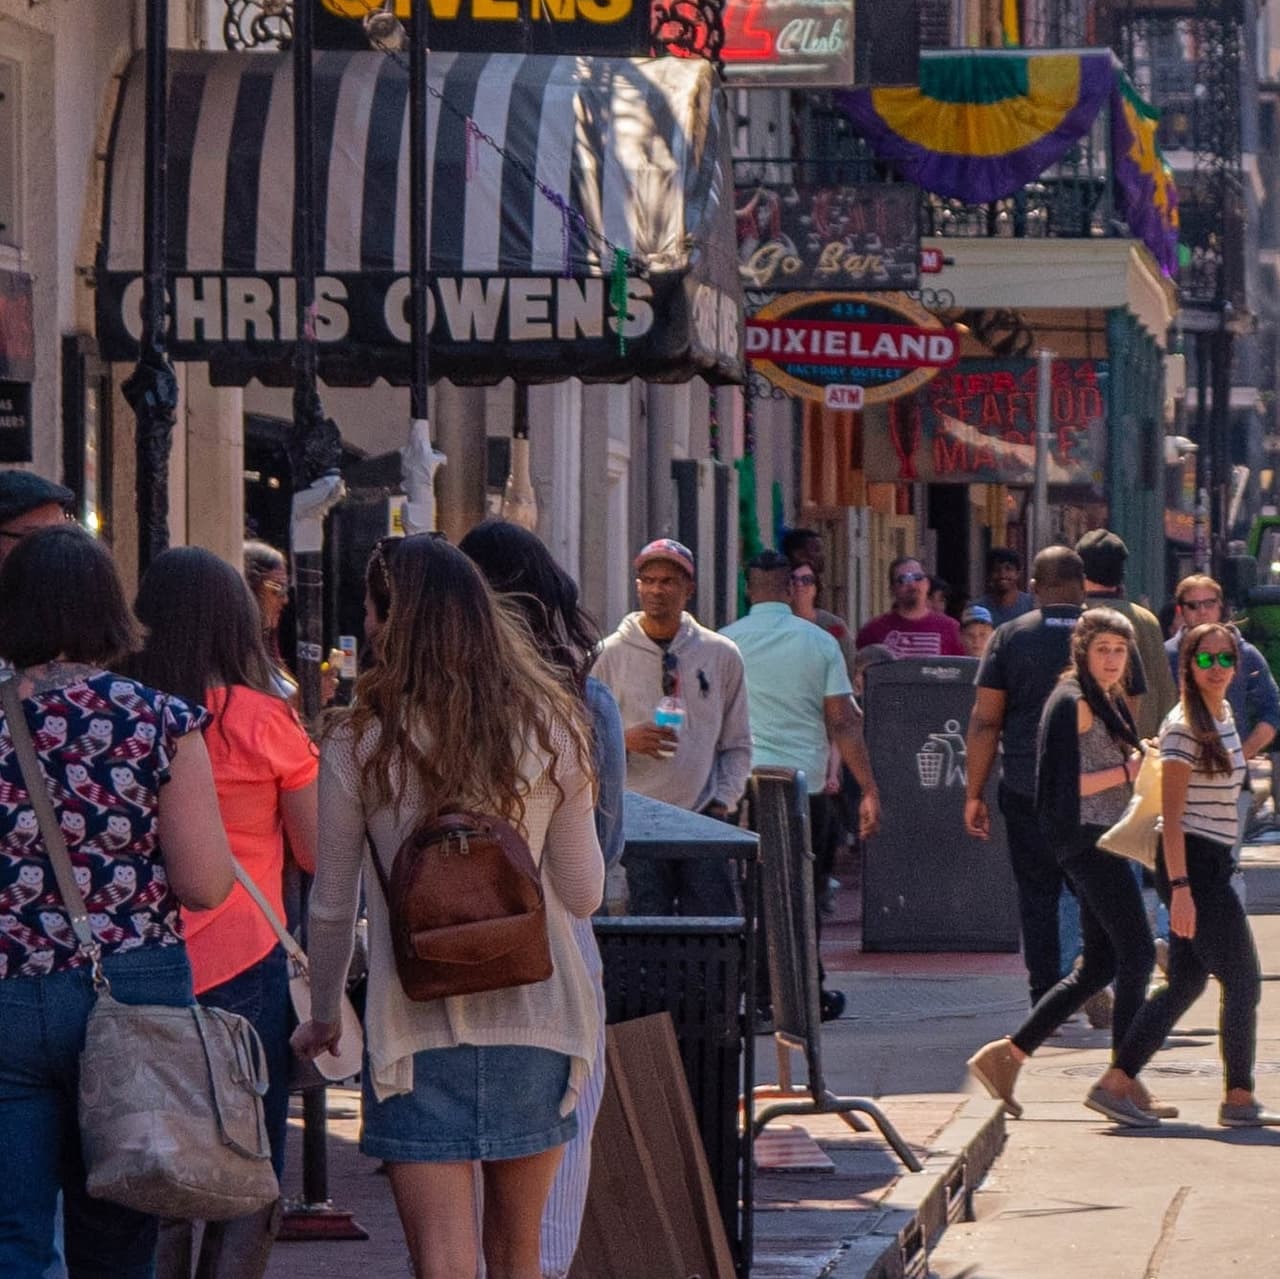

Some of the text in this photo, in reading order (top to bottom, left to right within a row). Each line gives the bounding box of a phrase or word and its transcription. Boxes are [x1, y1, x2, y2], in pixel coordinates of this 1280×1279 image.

[820, 241, 883, 274] Bar
[121, 275, 350, 343] CHRIS
[383, 275, 654, 344] OWENS
[745, 325, 954, 362] DIXIELAND
[828, 390, 861, 405] ATM
[933, 385, 1104, 422] SEAFOD
